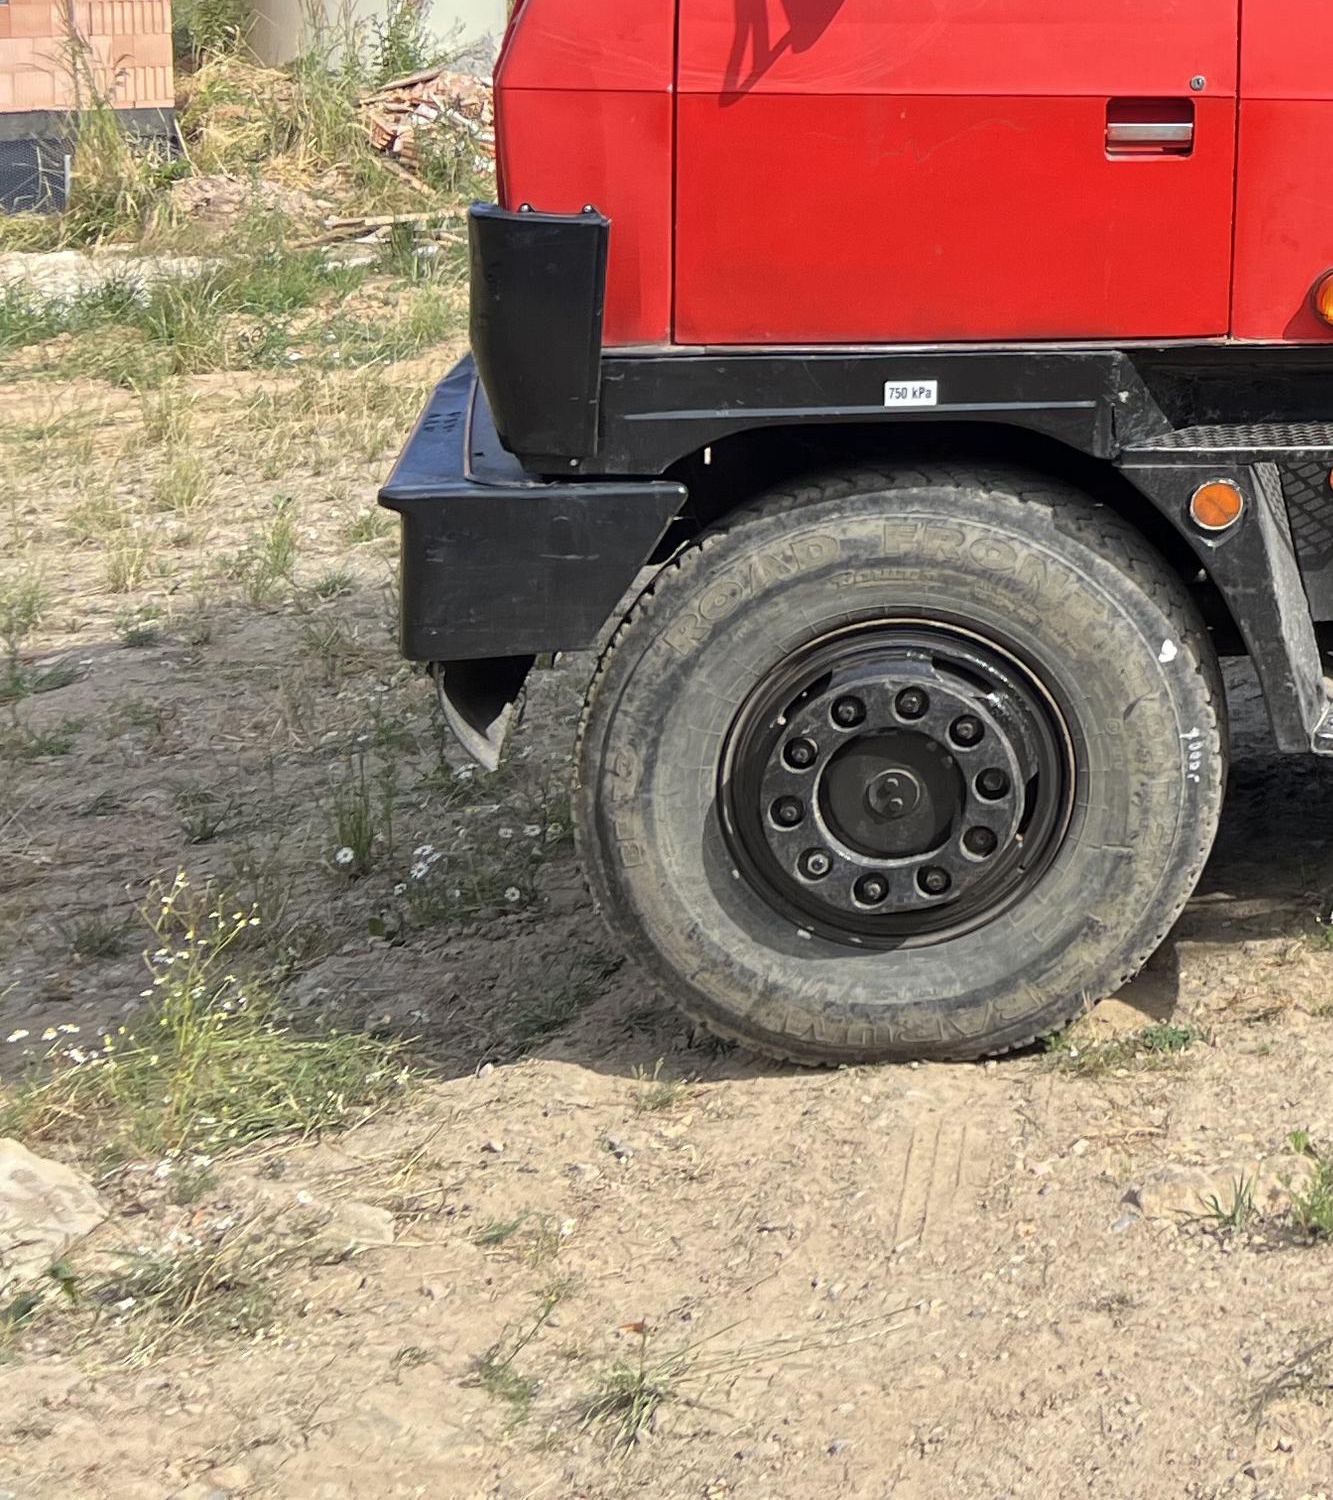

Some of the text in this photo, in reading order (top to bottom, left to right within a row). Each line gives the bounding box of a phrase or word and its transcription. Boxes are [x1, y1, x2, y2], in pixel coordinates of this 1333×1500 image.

[888, 386, 932, 400] 750 kPa
[663, 531, 840, 656] ROAD
